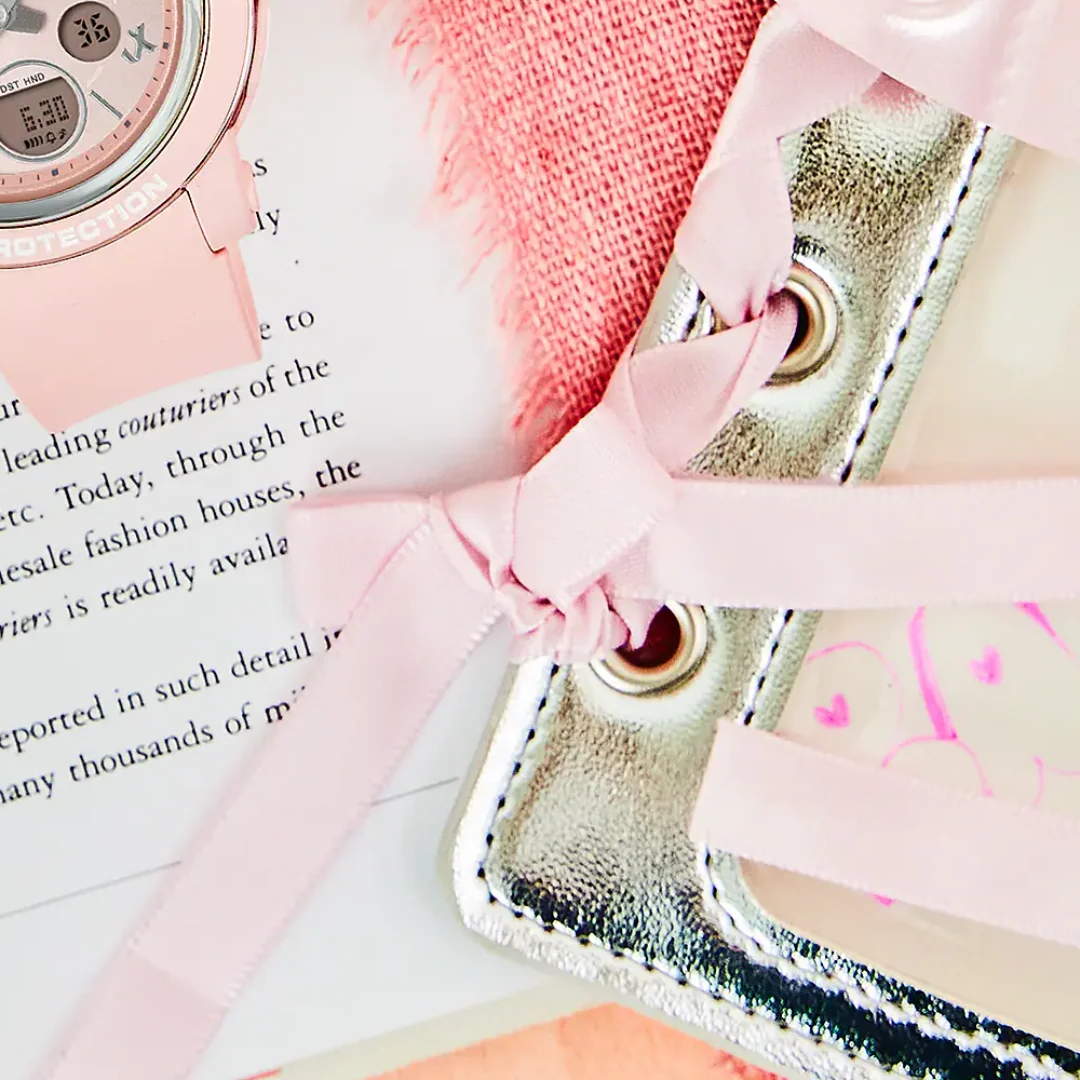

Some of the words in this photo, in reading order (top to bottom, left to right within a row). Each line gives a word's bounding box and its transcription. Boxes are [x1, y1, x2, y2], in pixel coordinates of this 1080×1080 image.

[73, 13, 111, 49] 36
[0, 79, 22, 94] DST
[23, 72, 47, 88] HND
[1, 428, 112, 474] leading
[118, 386, 241, 440] couturiers
[248, 364, 276, 398] of
[284, 358, 330, 388] the
[54, 470, 154, 511] Today,
[166, 422, 286, 479] through
[299, 408, 346, 438] the
[84, 514, 188, 559] fashion
[196, 480, 306, 524] houses,
[314, 458, 362, 489] the
[64, 594, 89, 620] is
[100, 561, 196, 610] readily
[114, 688, 146, 714] in
[154, 662, 221, 702] such
[230, 631, 312, 678] detail
[68, 720, 214, 782] thousands
[224, 701, 252, 736] of
